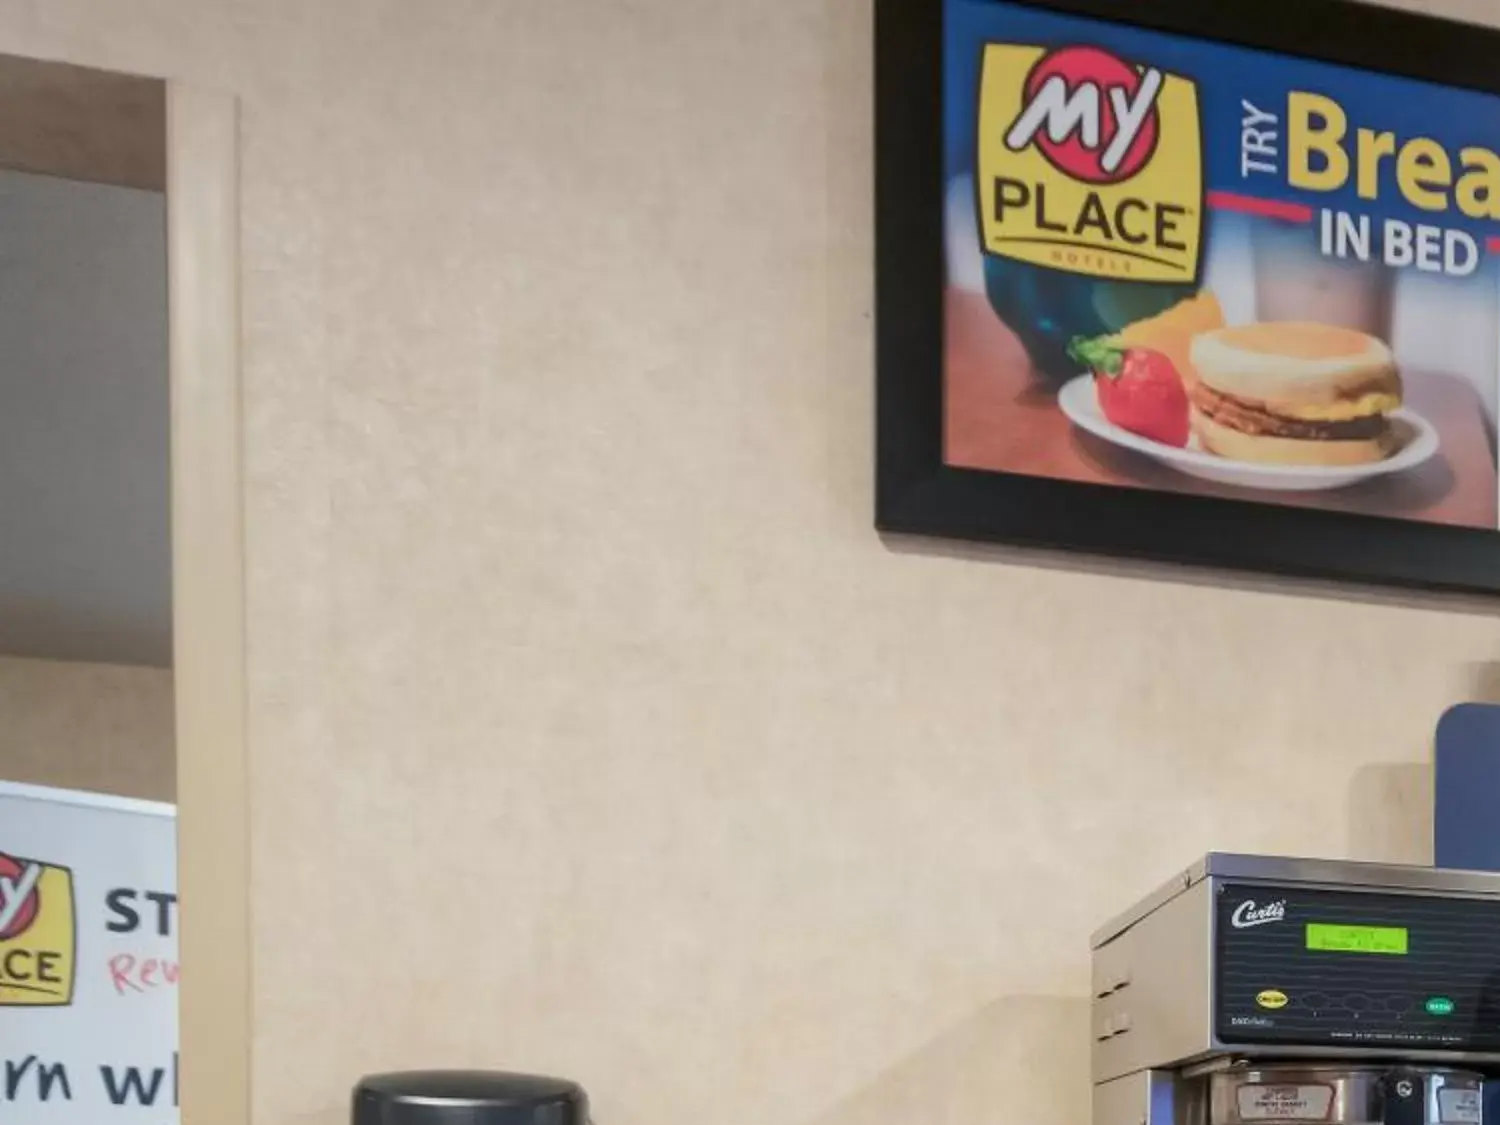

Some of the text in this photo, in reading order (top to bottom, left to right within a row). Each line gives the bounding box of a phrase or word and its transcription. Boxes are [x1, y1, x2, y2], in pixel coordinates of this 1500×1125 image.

[1242, 100, 1278, 177] TRY
[994, 177, 1187, 251] PLACE
[1321, 209, 1478, 277] IN BED
[105, 888, 178, 935] ST
[1231, 899, 1286, 928] Curtis
[0, 1055, 72, 1102] rn
